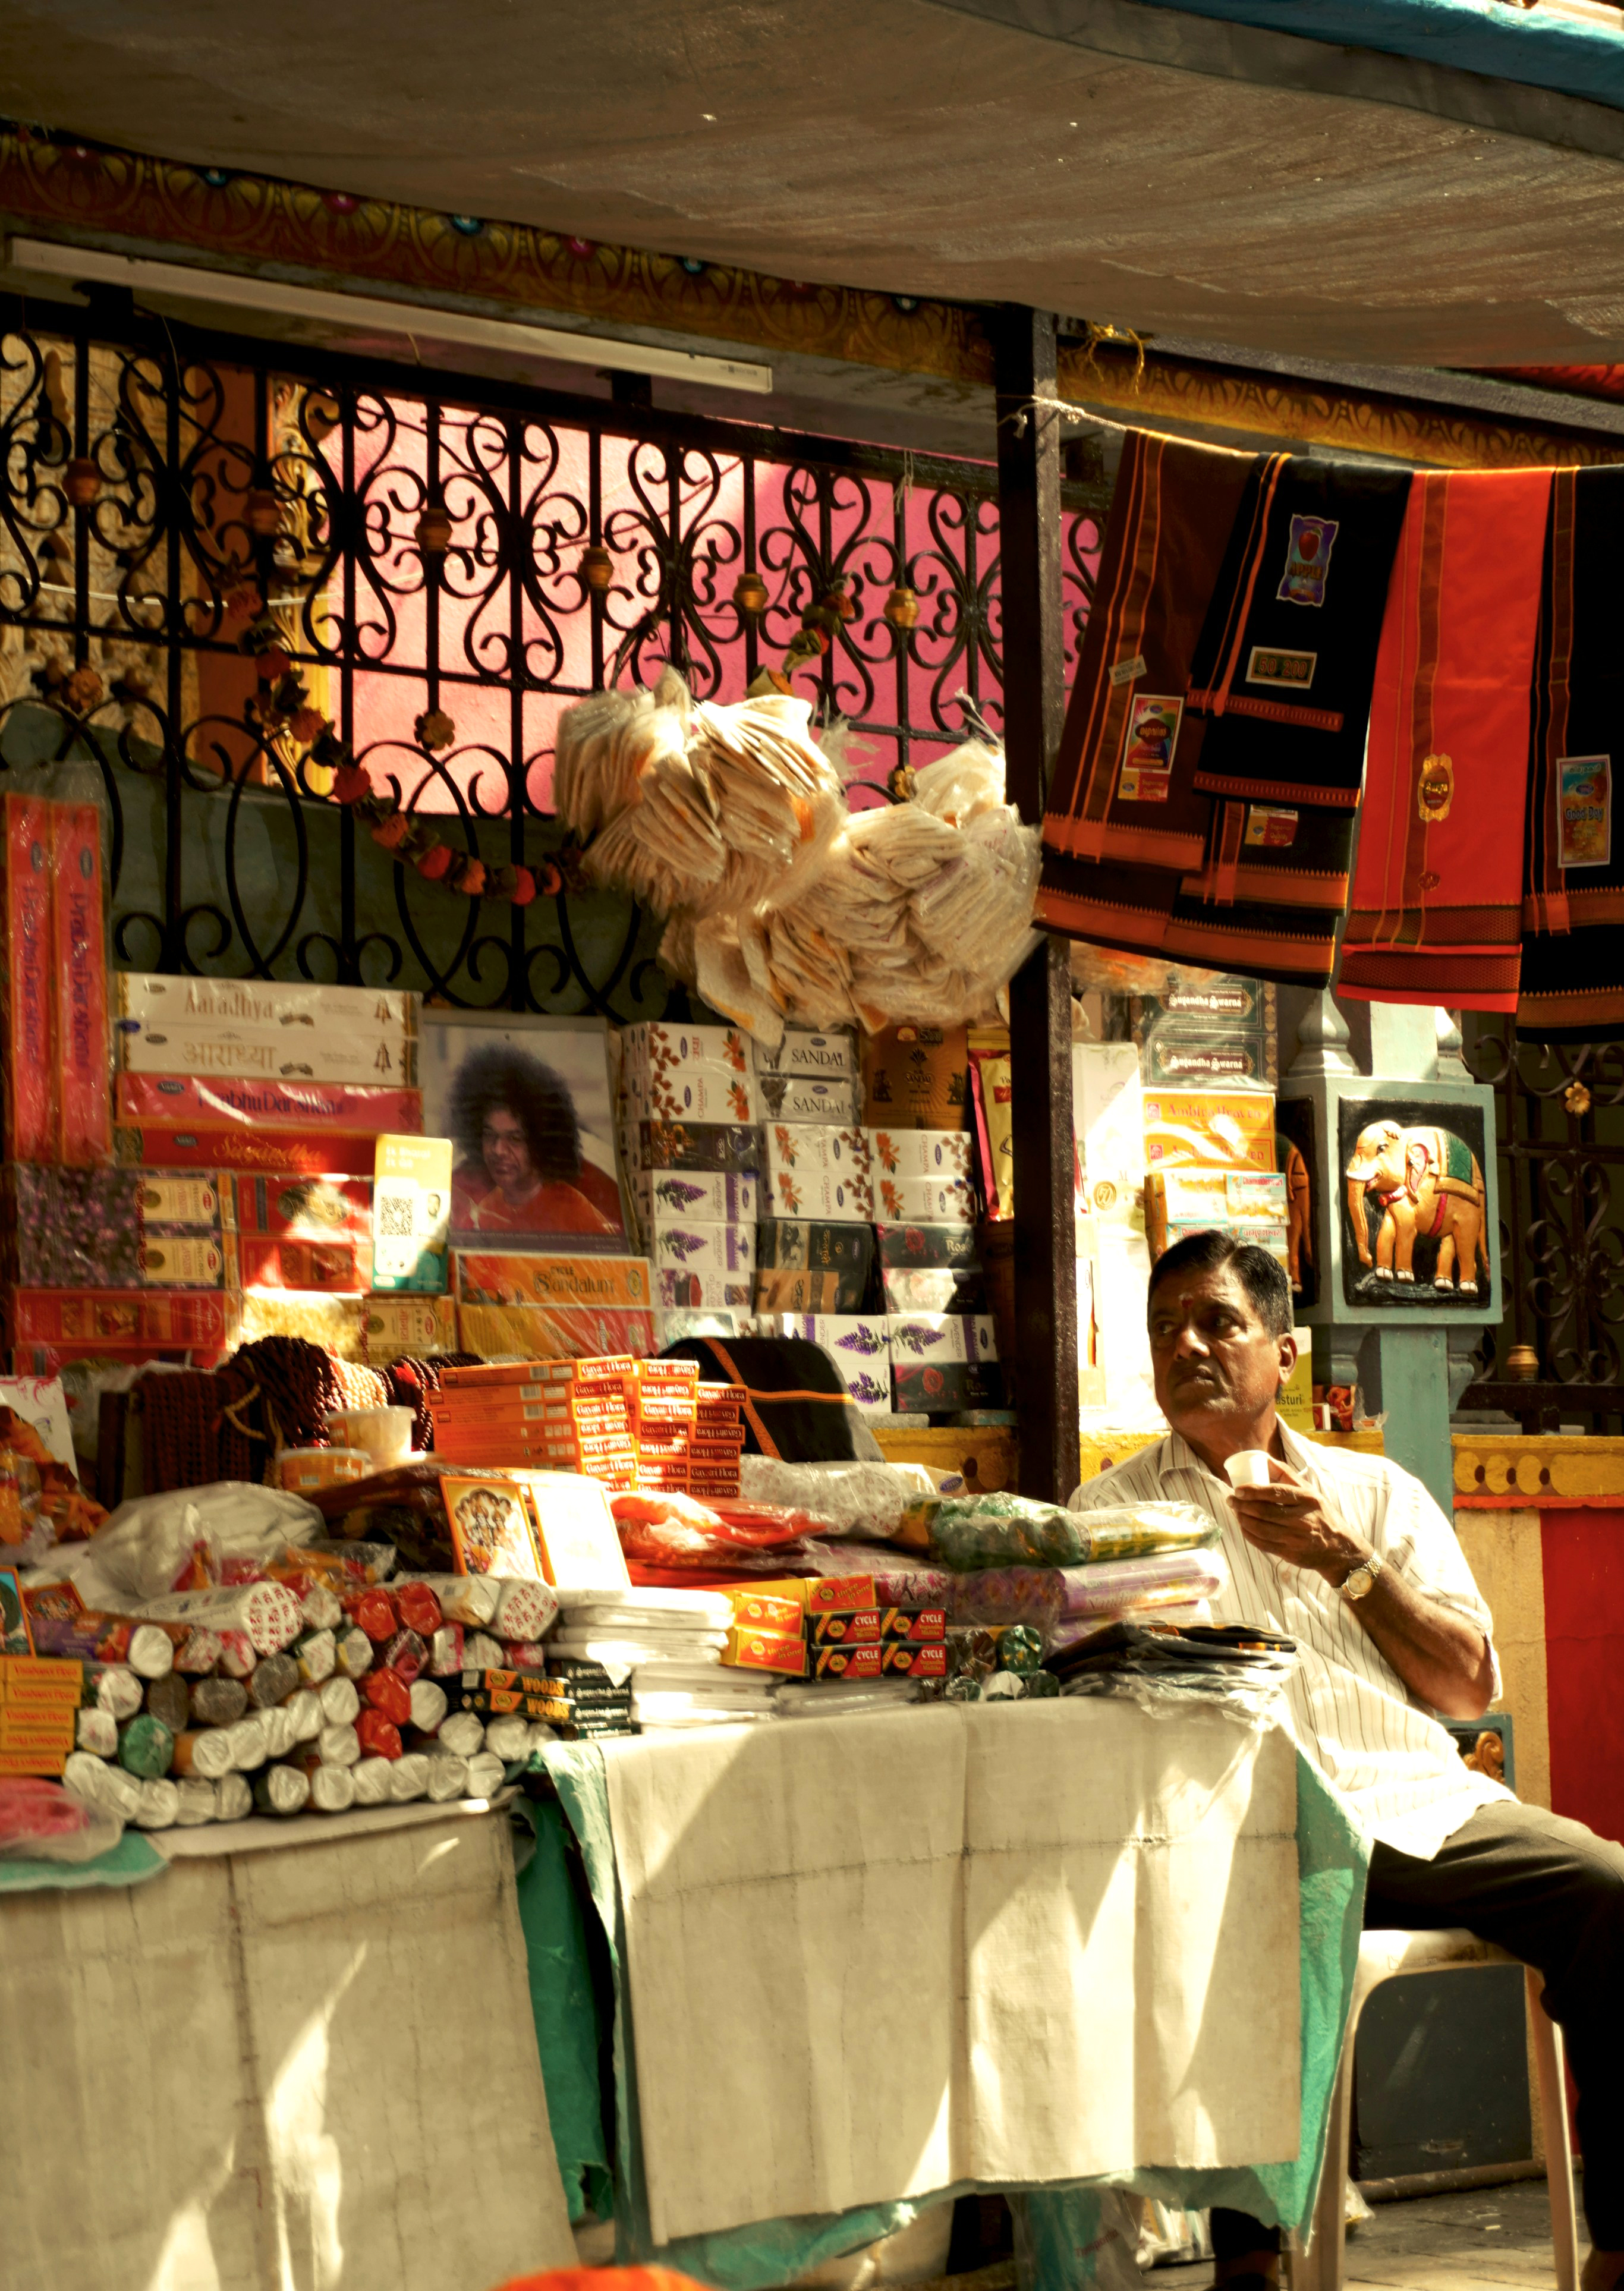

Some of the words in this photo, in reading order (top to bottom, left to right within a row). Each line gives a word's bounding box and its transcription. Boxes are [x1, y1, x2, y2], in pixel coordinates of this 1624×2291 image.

[1290, 561, 1323, 580] APPLE
[1258, 658, 1276, 674] 50
[1283, 660, 1307, 677] 200
[1565, 807, 1587, 821] Good
[1588, 806, 1603, 822] Day
[185, 990, 274, 1020] Aaradhya
[1169, 993, 1208, 1008] Sugandha
[1209, 995, 1242, 1010] Swarna
[183, 1041, 277, 1070] आराध्या
[792, 1048, 846, 1066] SANDAL
[1170, 1055, 1210, 1069] Sugandha
[1211, 1058, 1243, 1071] Swarna
[715, 1176, 723, 1217] LAVENDER
[823, 1175, 831, 1214] CHAMPA
[926, 1182, 934, 1222] CHAMPA
[550, 1266, 574, 1275] CYCLE
[952, 1318, 962, 1358] LAVENDER
[611, 1360, 631, 1372] Flora
[648, 1365, 666, 1376] Flora
[603, 1382, 622, 1392] Flora
[641, 1386, 660, 1396] Flora
[726, 1389, 745, 1400] Flora
[1276, 1394, 1302, 1405] asturi
[606, 1402, 625, 1413] Flora
[673, 1405, 692, 1416] Flora
[581, 1423, 600, 1434] Flora
[642, 1425, 668, 1436] Gayatri
[669, 1425, 688, 1436] Flora
[697, 1428, 714, 1439] Flora
[716, 1429, 742, 1438] Gayatri
[583, 1442, 603, 1454] Flora
[640, 1444, 659, 1455] Flora
[691, 1447, 710, 1458] Flora
[615, 1460, 634, 1471] Flora
[667, 1465, 685, 1474] Flora
[718, 1468, 737, 1478] Flora
[691, 1486, 710, 1496] Flora
[837, 1583, 858, 1598] three
[848, 1591, 856, 1601] in
[856, 1584, 871, 1596] one
[775, 1613, 784, 1623] in
[783, 1611, 800, 1621] one
[855, 1615, 877, 1625] CYCLE
[920, 1614, 942, 1623] CYCLE
[767, 1644, 790, 1656] three
[778, 1653, 787, 1661] in
[786, 1648, 802, 1659] one
[856, 1650, 879, 1660] CYCLE
[921, 1650, 943, 1659] CYCLE
[522, 1676, 564, 1698] WOODS
[527, 1697, 570, 1720] WOODS
